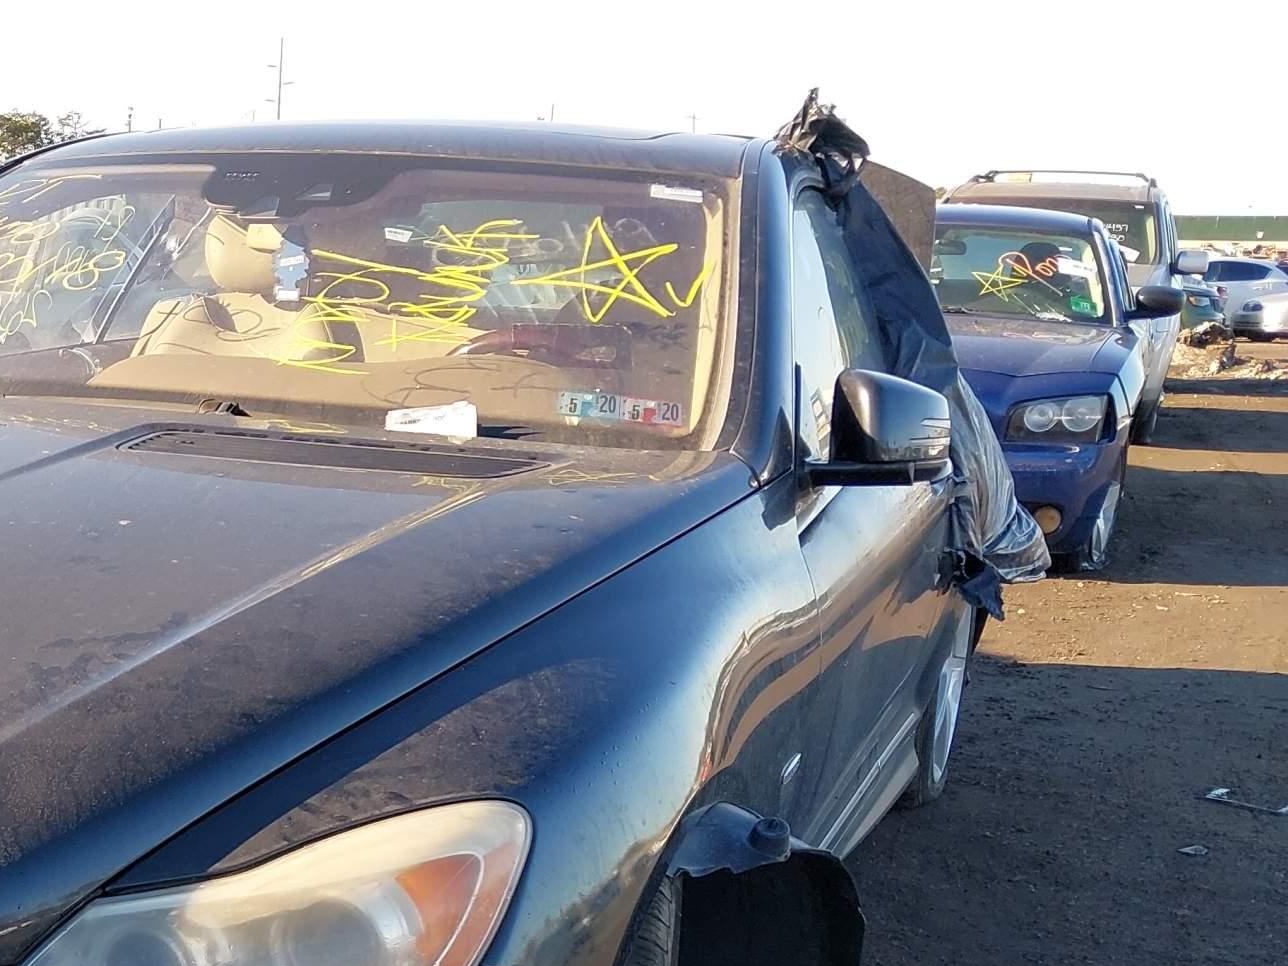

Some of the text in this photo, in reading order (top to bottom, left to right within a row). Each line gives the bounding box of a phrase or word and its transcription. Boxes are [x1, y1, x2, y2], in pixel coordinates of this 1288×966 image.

[569, 394, 617, 414] 5 20
[631, 403, 680, 421] 5 20
